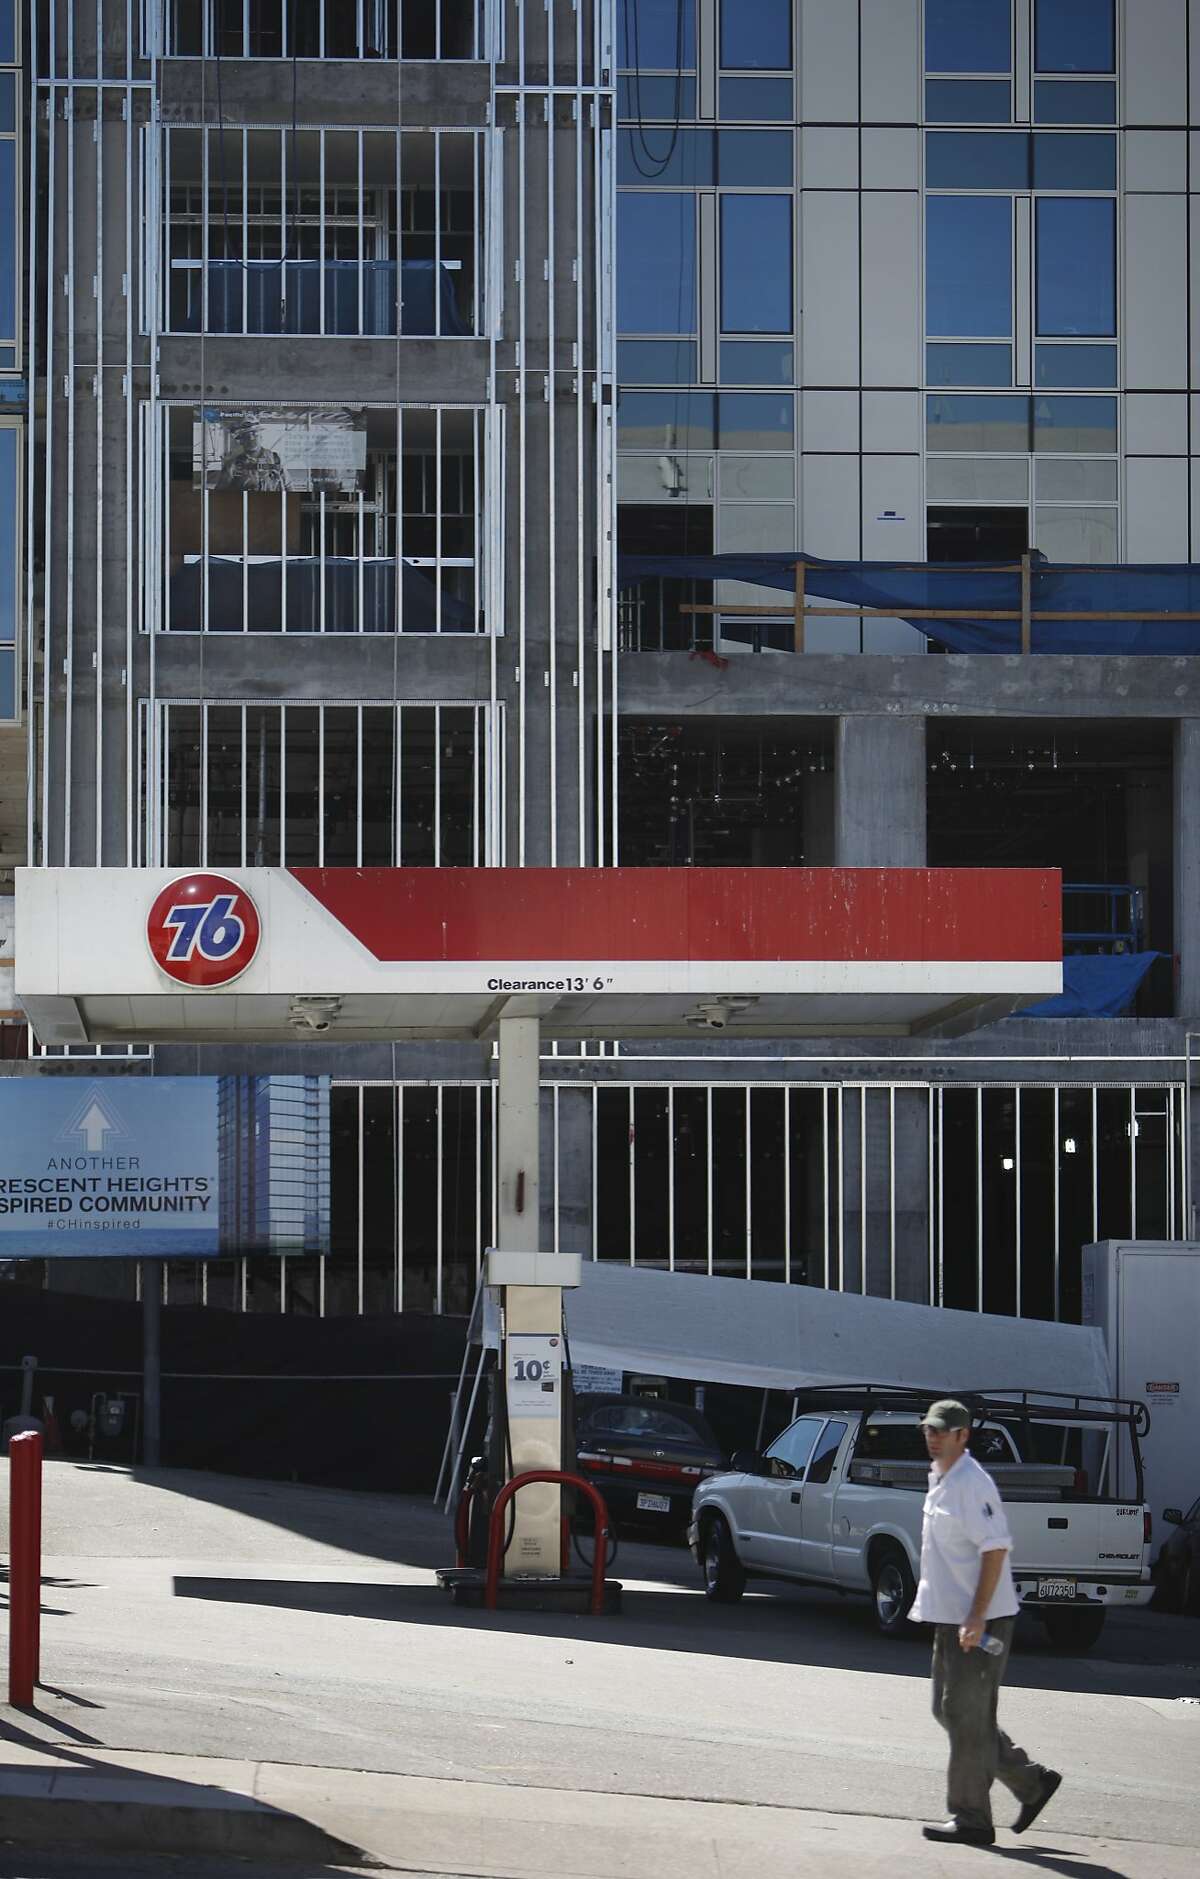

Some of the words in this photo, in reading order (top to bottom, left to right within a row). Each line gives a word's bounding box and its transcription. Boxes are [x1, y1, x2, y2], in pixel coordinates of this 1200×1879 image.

[162, 894, 245, 961] 76
[487, 978, 564, 990] Clearance
[47, 1156, 141, 1170] ANOTHER
[79, 1196, 211, 1213] COMMUNITY
[47, 1218, 141, 1231] #CHinspired
